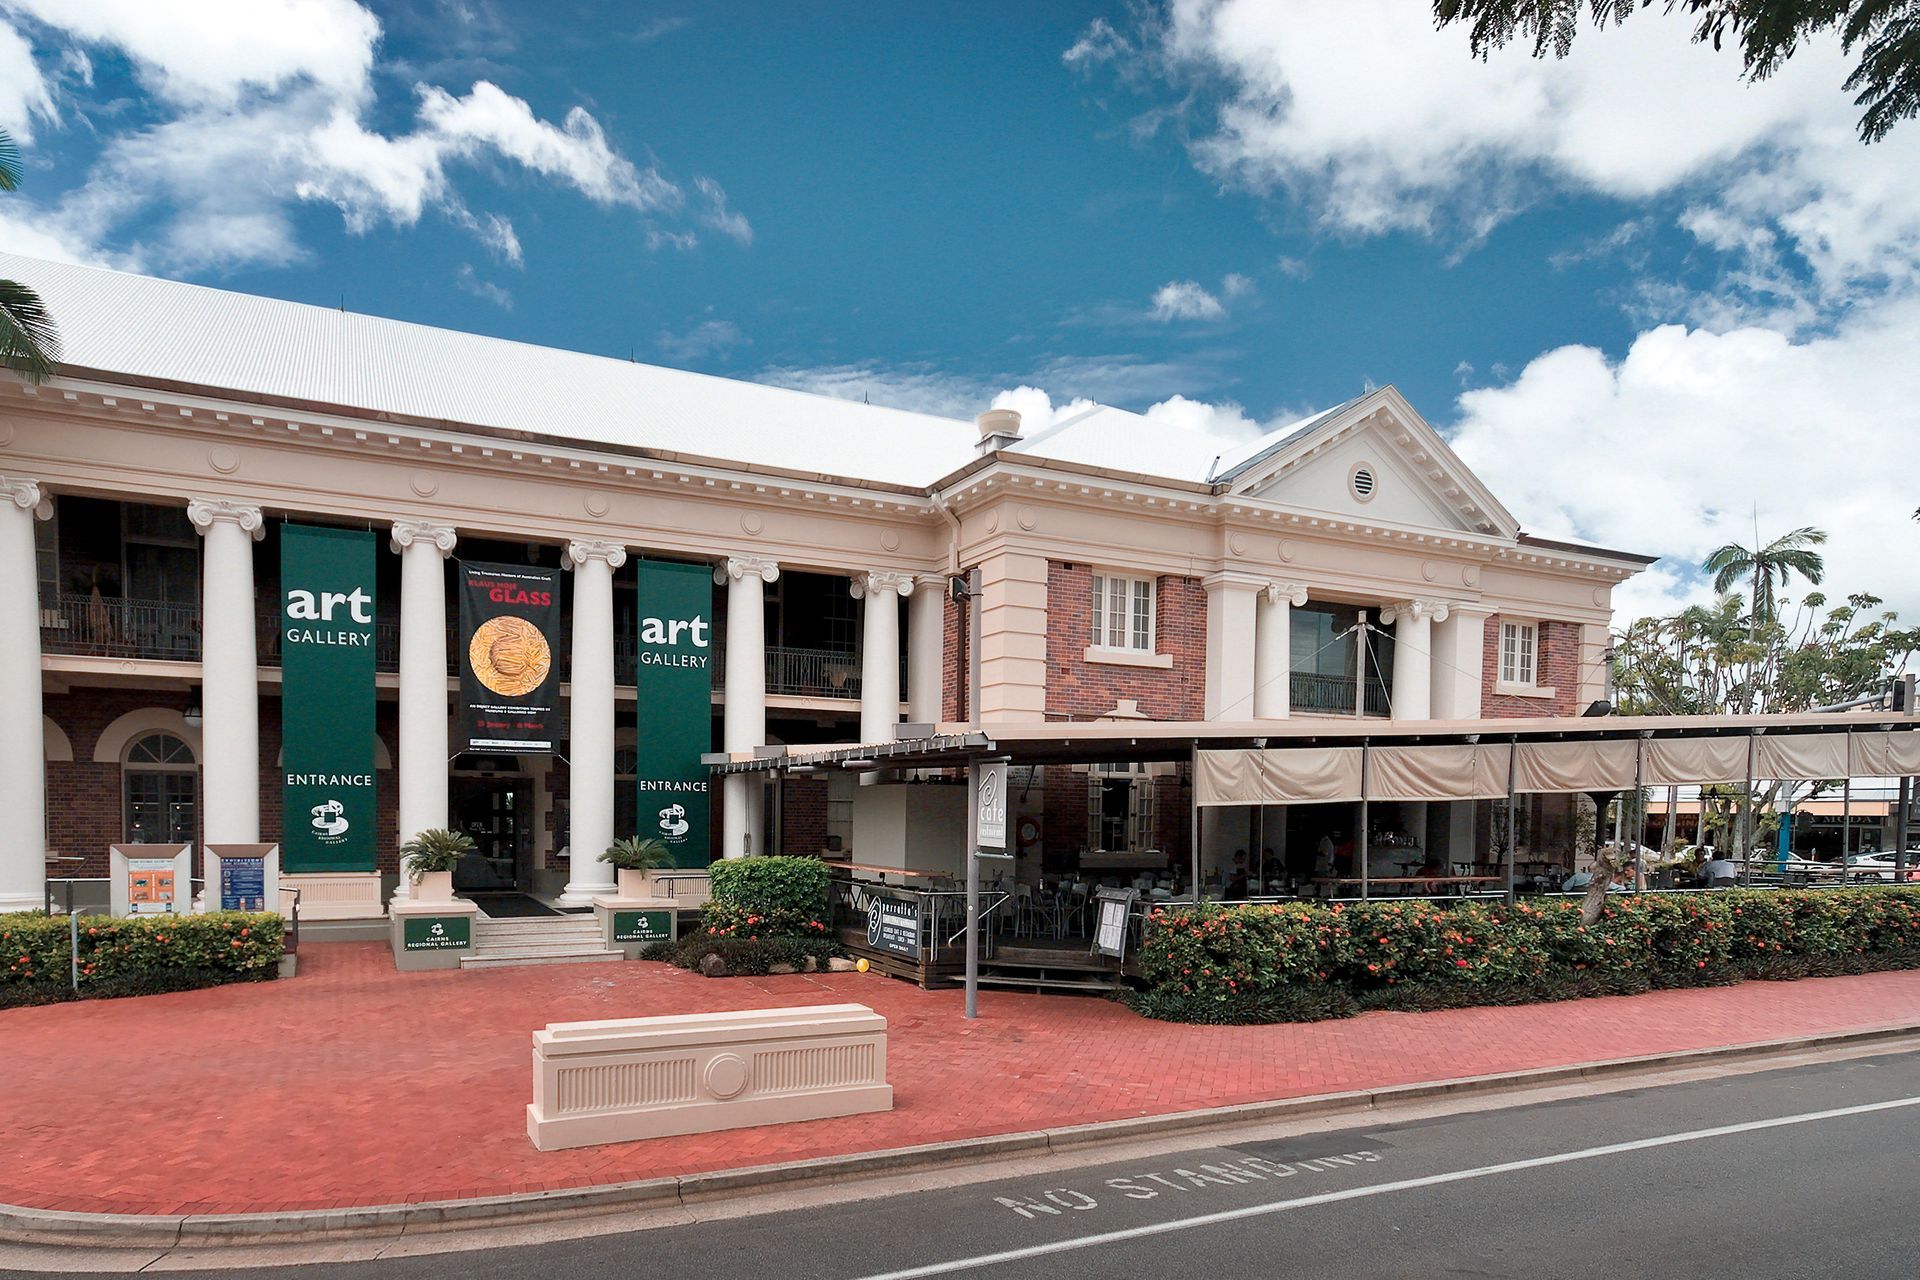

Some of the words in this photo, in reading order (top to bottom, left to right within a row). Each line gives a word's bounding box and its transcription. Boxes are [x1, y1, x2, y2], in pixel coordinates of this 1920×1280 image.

[286, 586, 372, 624] art
[489, 588, 552, 606] GLASS
[286, 628, 371, 646] GALLERY
[641, 614, 709, 648] art
[641, 651, 708, 668] GALLERY
[287, 774, 372, 786] ENTRANCE
[640, 781, 707, 792] ENTRANCE
[993, 1188, 1098, 1219] NO
